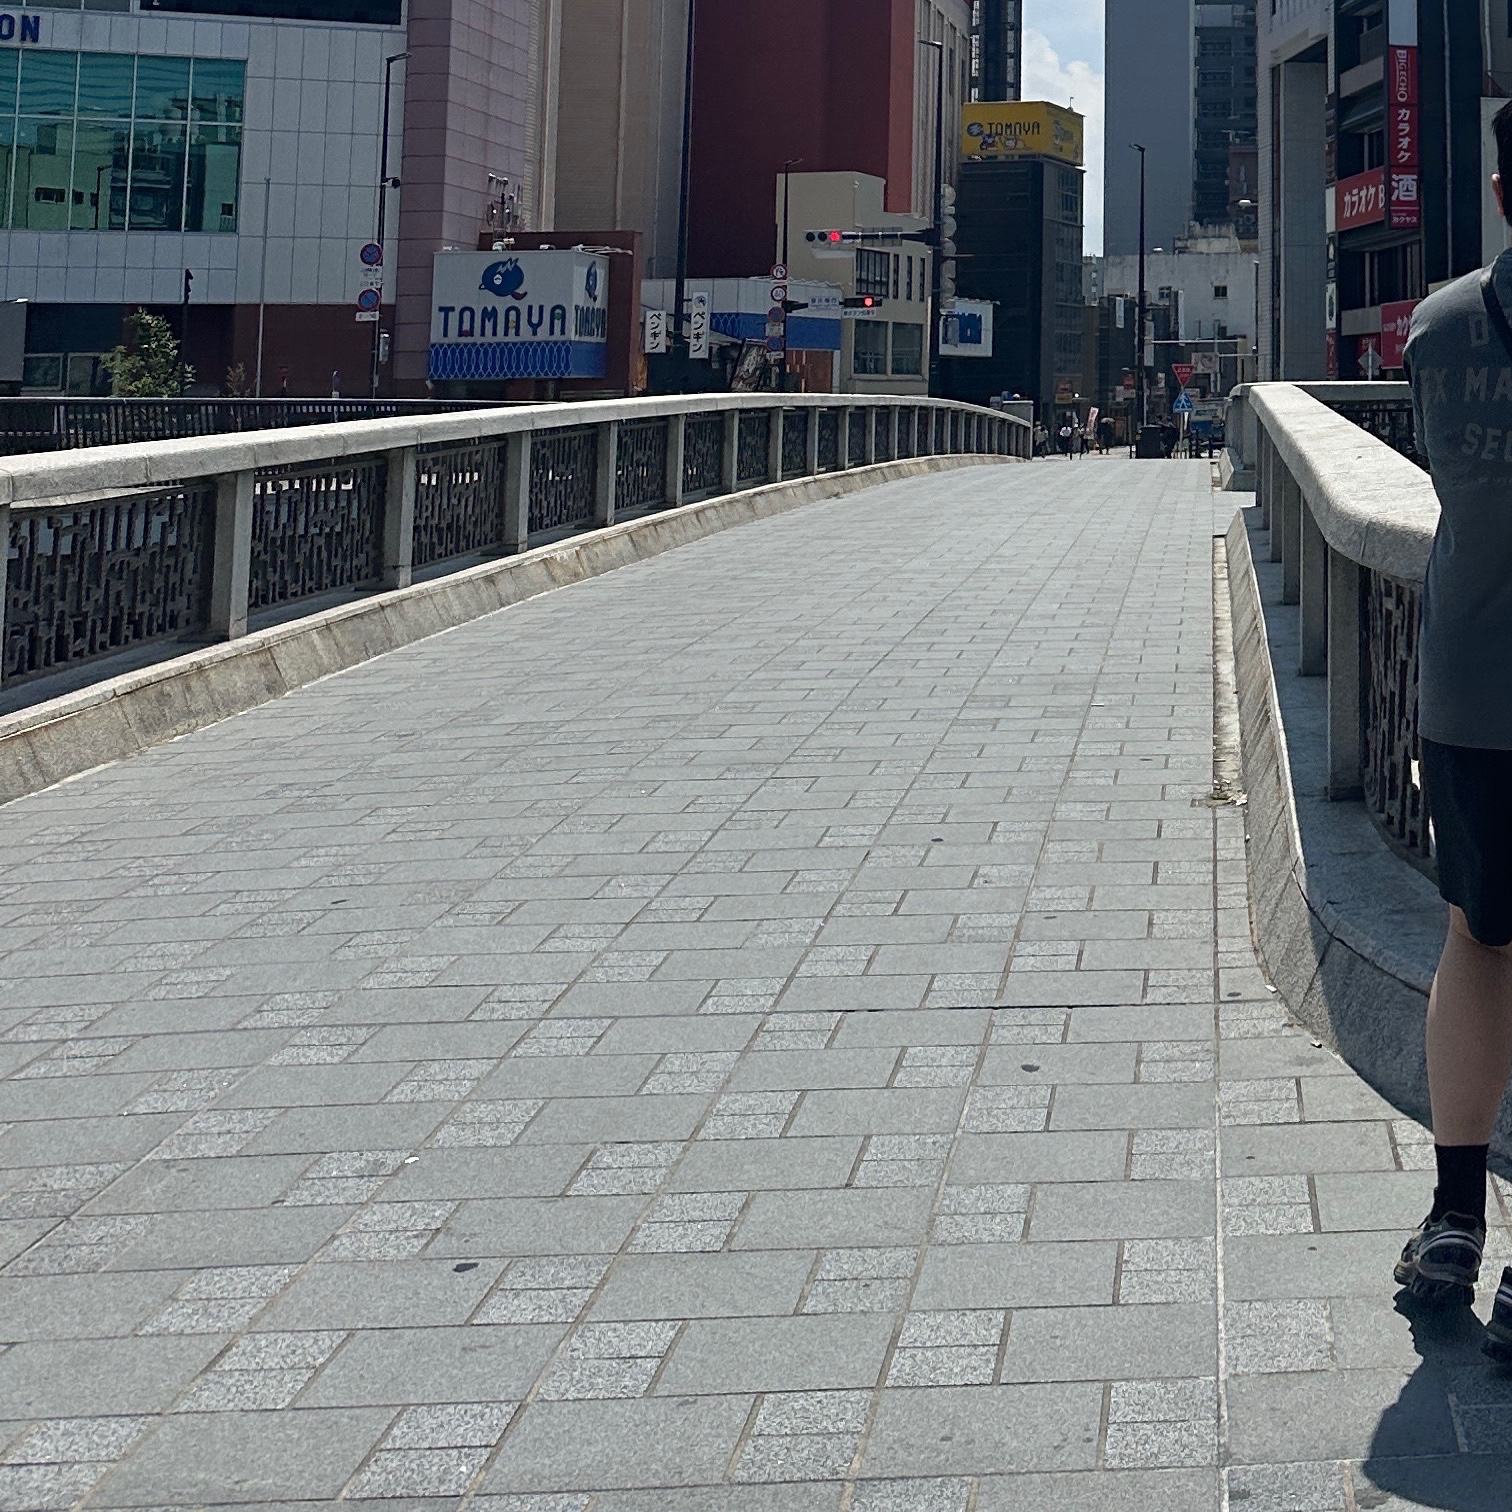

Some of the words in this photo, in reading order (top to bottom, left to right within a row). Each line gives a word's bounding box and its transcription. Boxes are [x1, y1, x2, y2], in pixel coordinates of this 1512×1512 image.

[1396, 108, 1411, 163] カラオケ
[1343, 183, 1377, 219] カラオケ
[1391, 174, 1418, 201] 酒
[438, 304, 567, 338] TAMAYA
[647, 312, 661, 350] ペンギン
[692, 311, 706, 352] ペンギン
